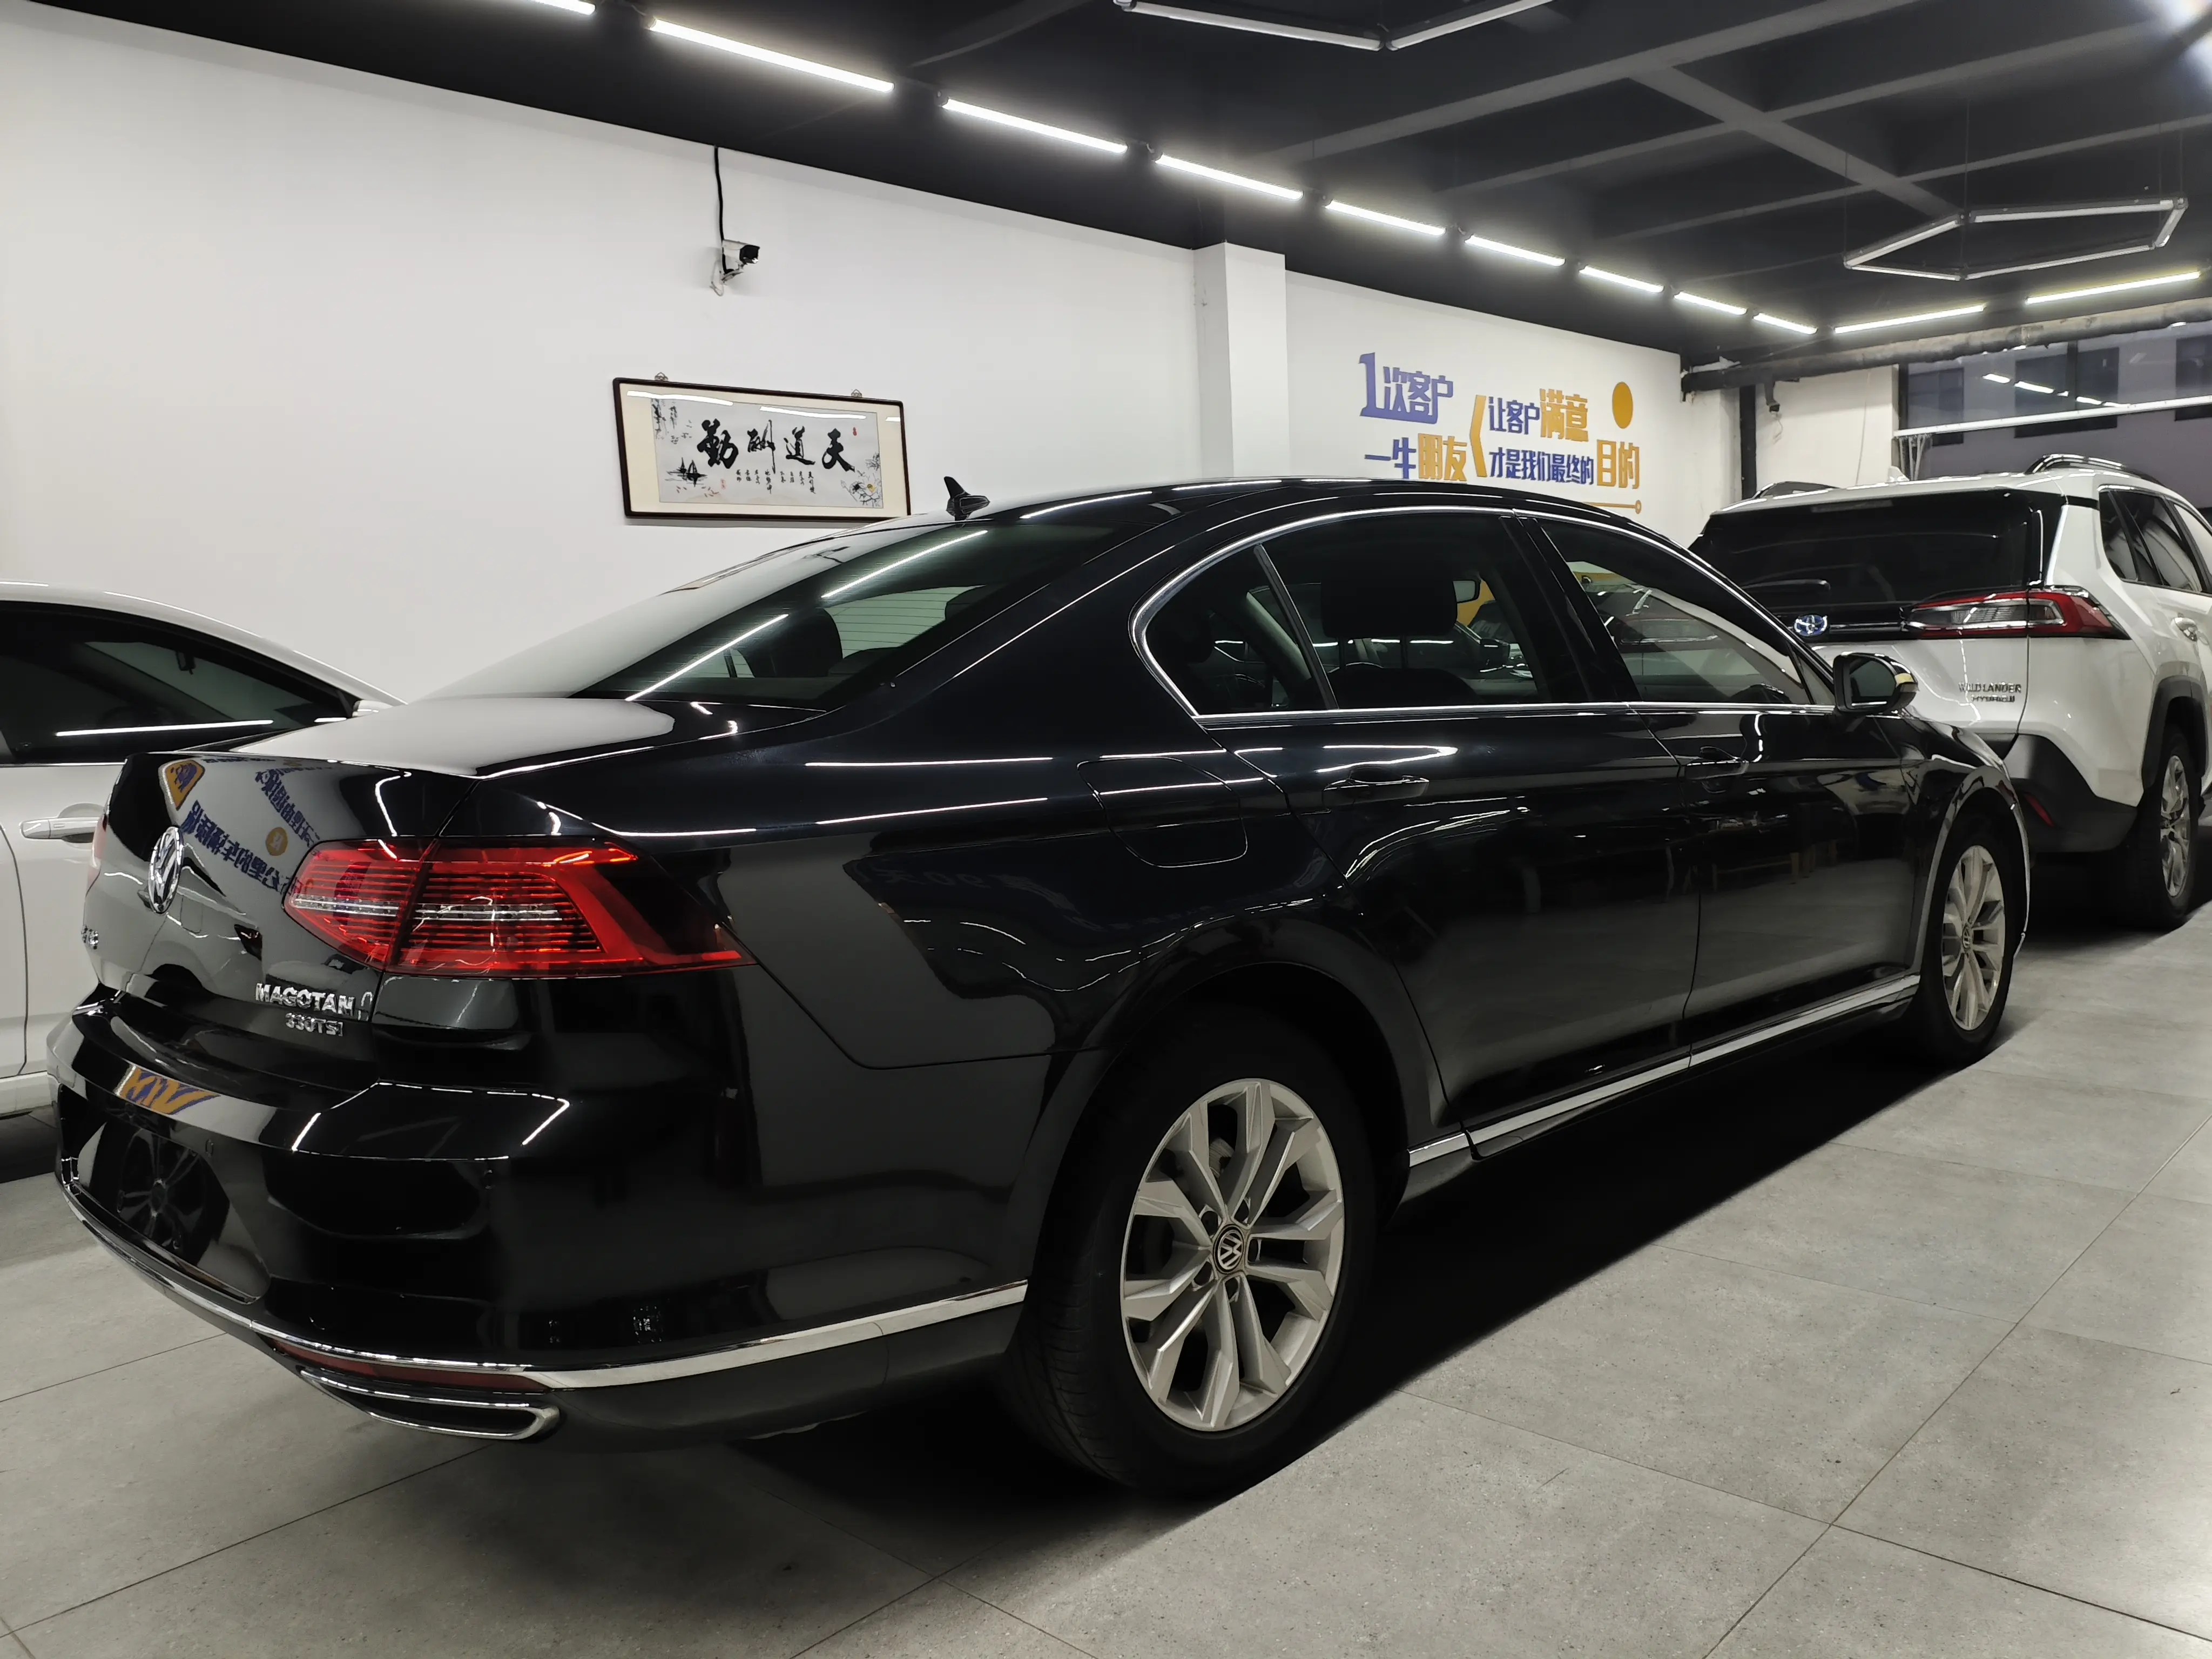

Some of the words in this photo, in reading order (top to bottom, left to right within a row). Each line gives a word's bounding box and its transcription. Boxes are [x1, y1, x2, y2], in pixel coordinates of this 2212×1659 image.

[1359, 352, 1453, 424] 1次客户
[1488, 388, 1588, 442] 让客户满意
[255, 983, 355, 1016] MAGOTAN
